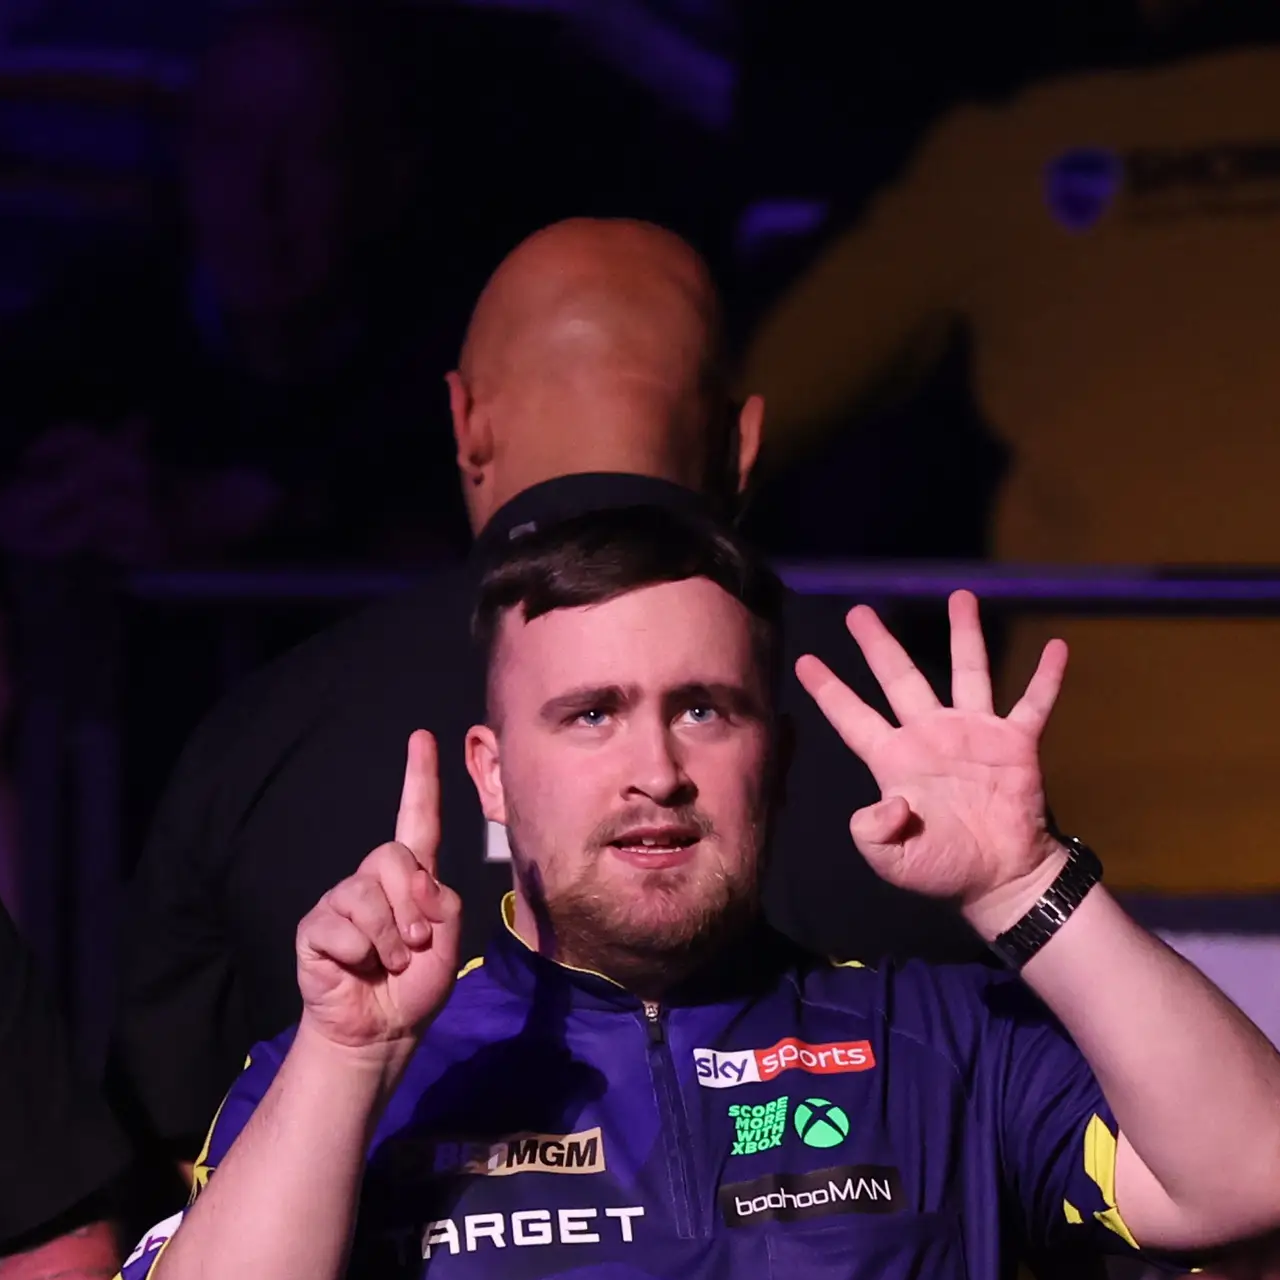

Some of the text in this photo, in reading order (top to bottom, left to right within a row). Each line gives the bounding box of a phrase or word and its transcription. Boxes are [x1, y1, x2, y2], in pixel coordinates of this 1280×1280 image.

[695, 1044, 868, 1082] sky sports
[728, 1095, 789, 1118] SCORE
[735, 1108, 787, 1131] MORE
[736, 1120, 785, 1143] WITH
[730, 1133, 783, 1156] XBOX
